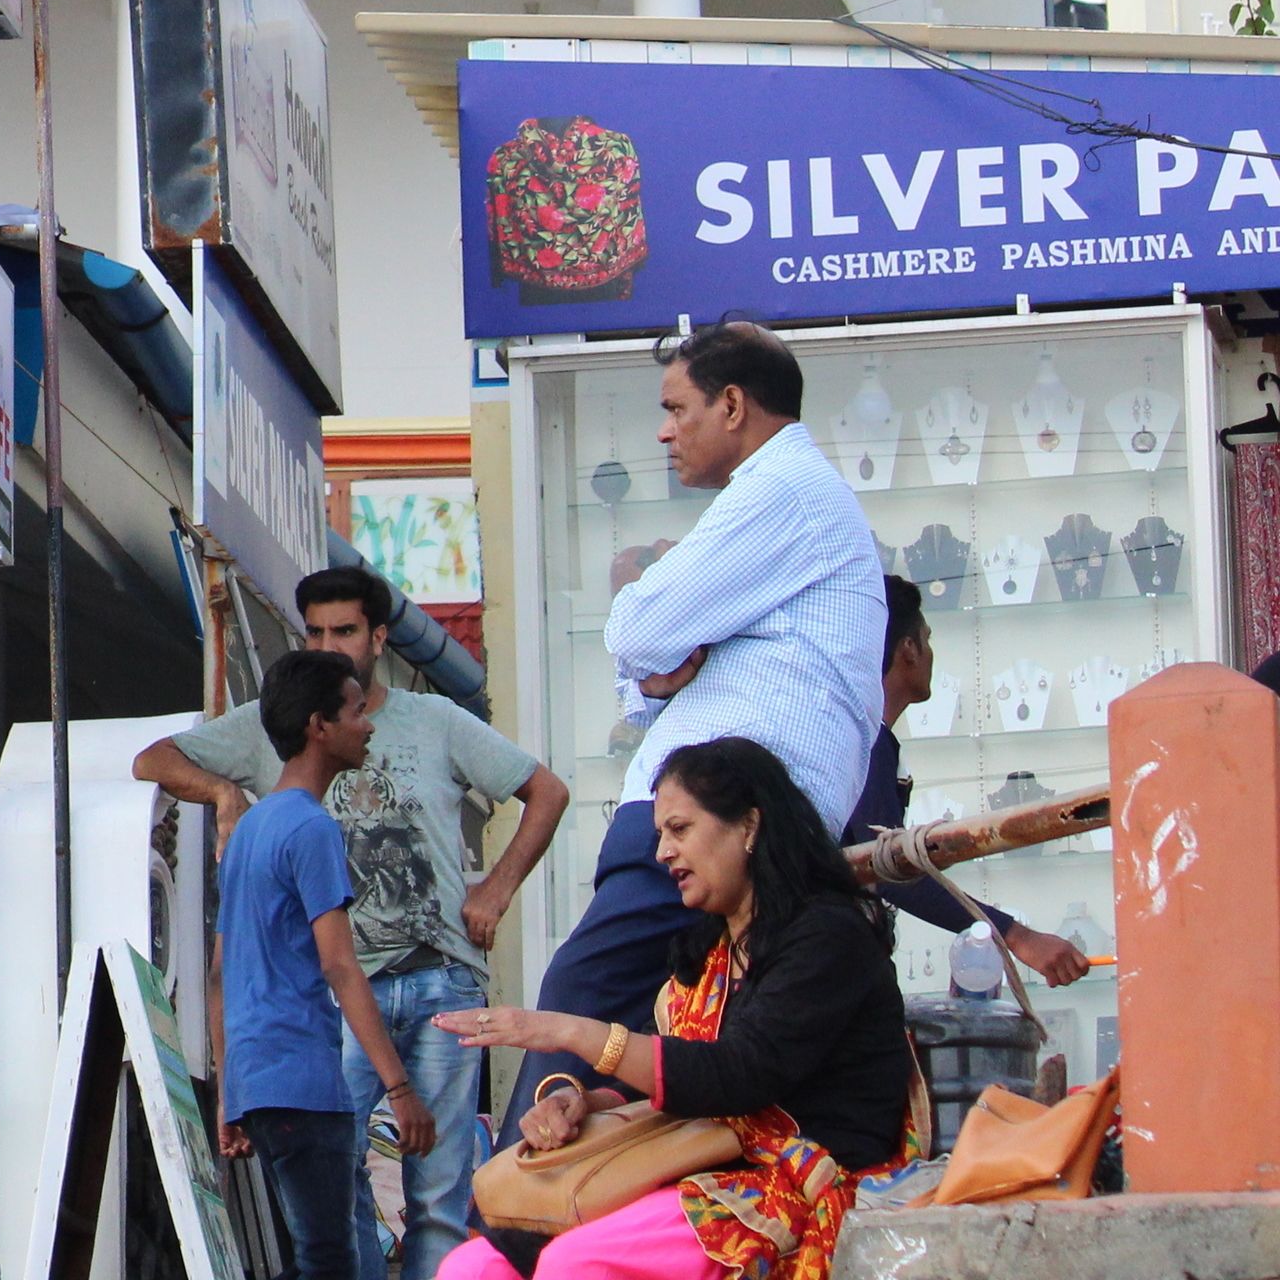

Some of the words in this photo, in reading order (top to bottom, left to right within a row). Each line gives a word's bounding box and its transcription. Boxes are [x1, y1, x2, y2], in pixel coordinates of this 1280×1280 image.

[694, 143, 1089, 245] SILVER
[1136, 129, 1280, 217] PA
[772, 246, 977, 284] CASHMERE
[1001, 232, 1193, 271] PASHMINA
[228, 366, 267, 527] SILVER
[269, 421, 313, 577] PALACE
